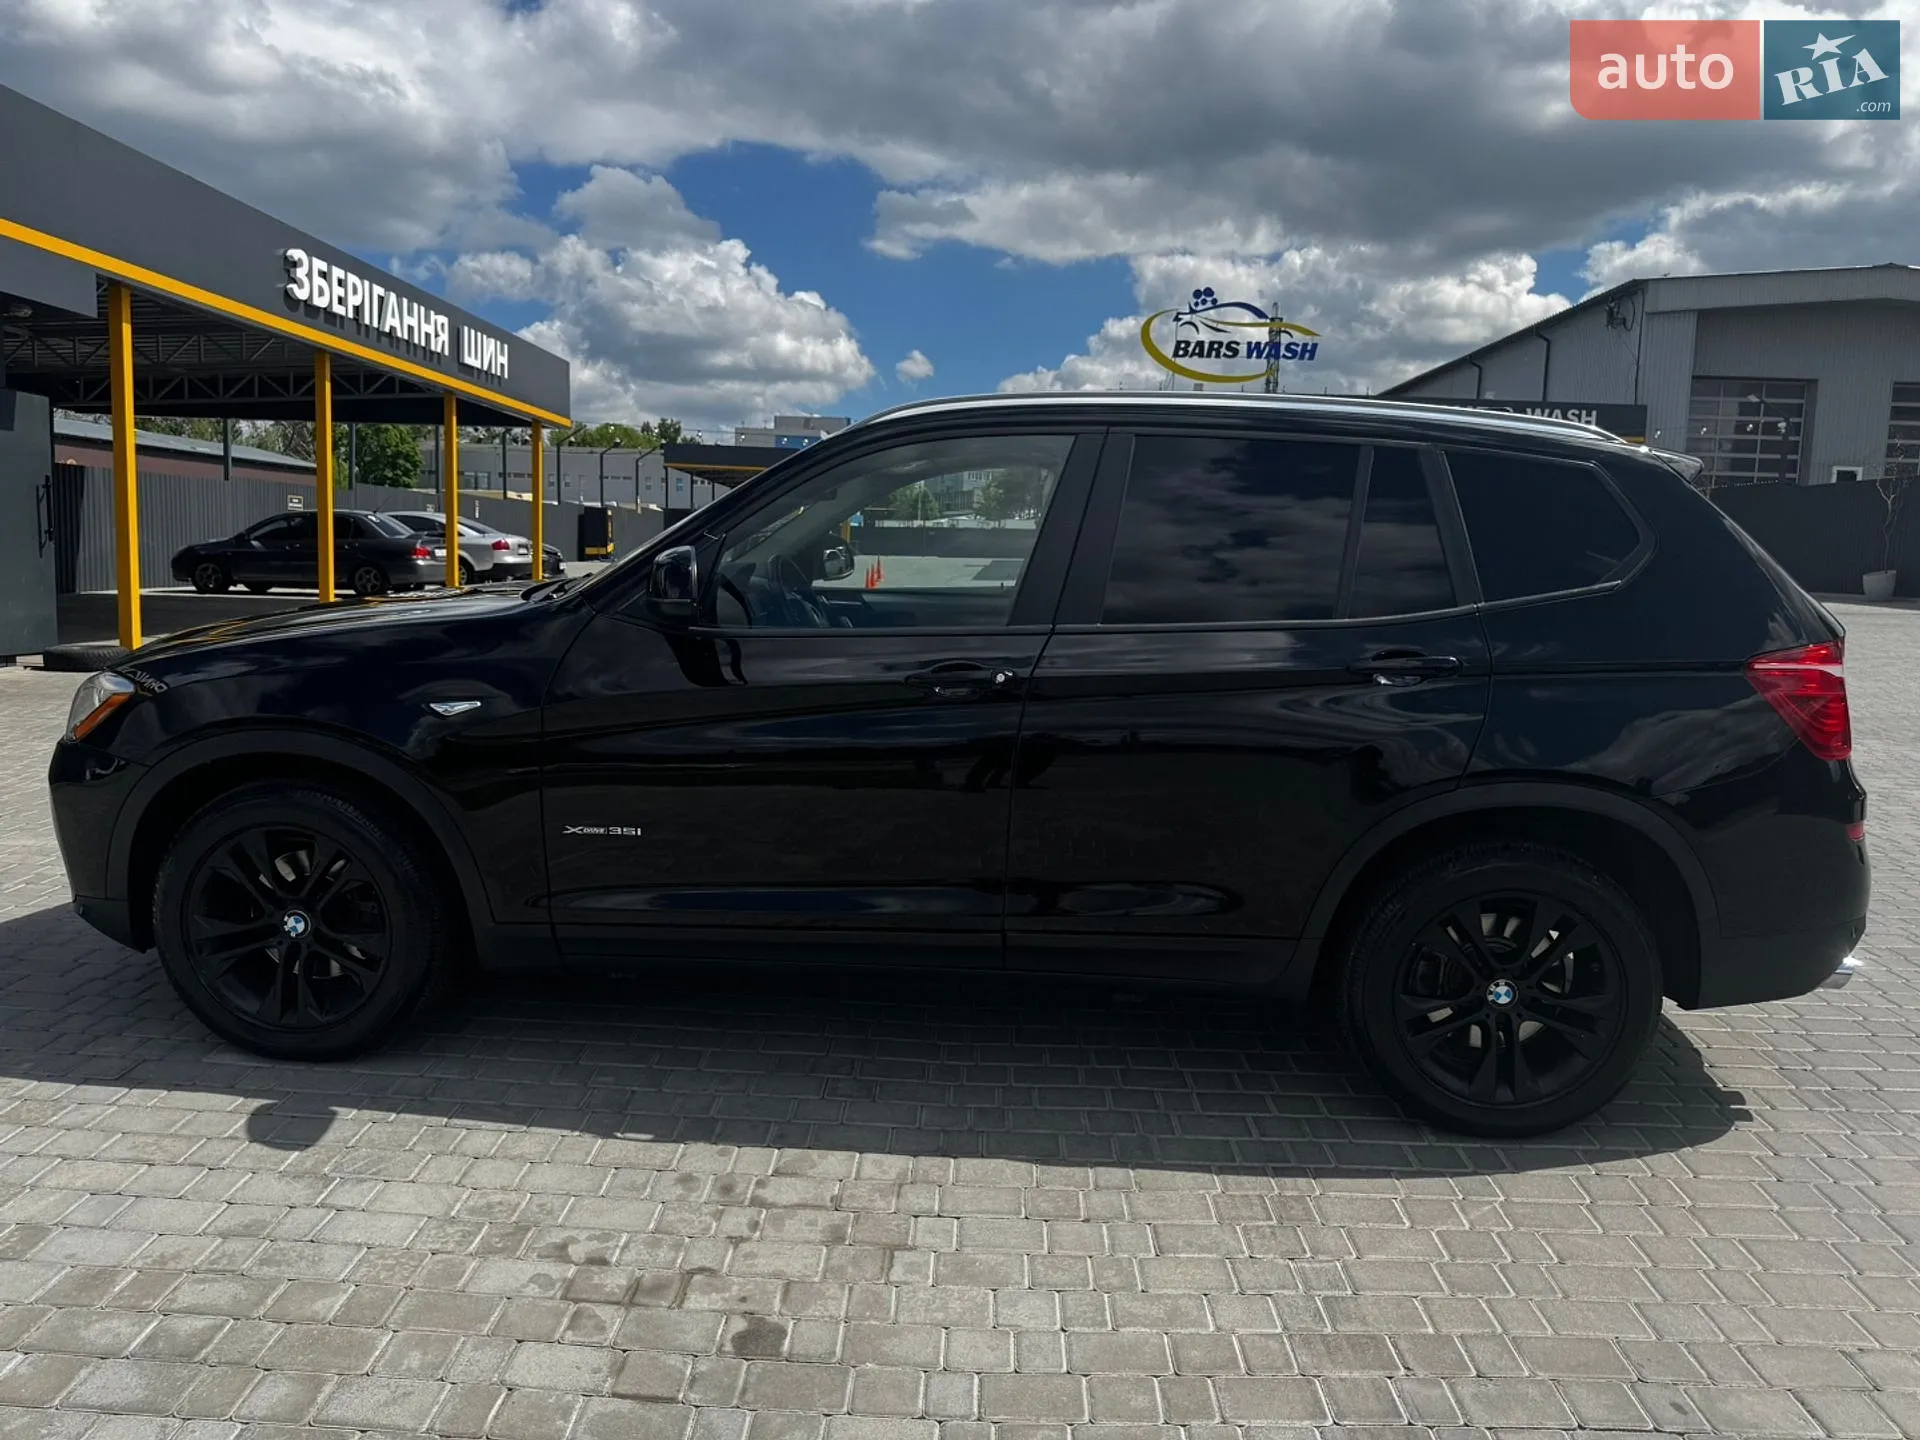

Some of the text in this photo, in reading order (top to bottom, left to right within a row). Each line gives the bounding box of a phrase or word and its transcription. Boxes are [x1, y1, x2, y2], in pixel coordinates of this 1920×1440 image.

[283, 248, 508, 379] ЗБЕРІГАННЯ ШИН
[1172, 339, 1318, 361] BARS WASH
